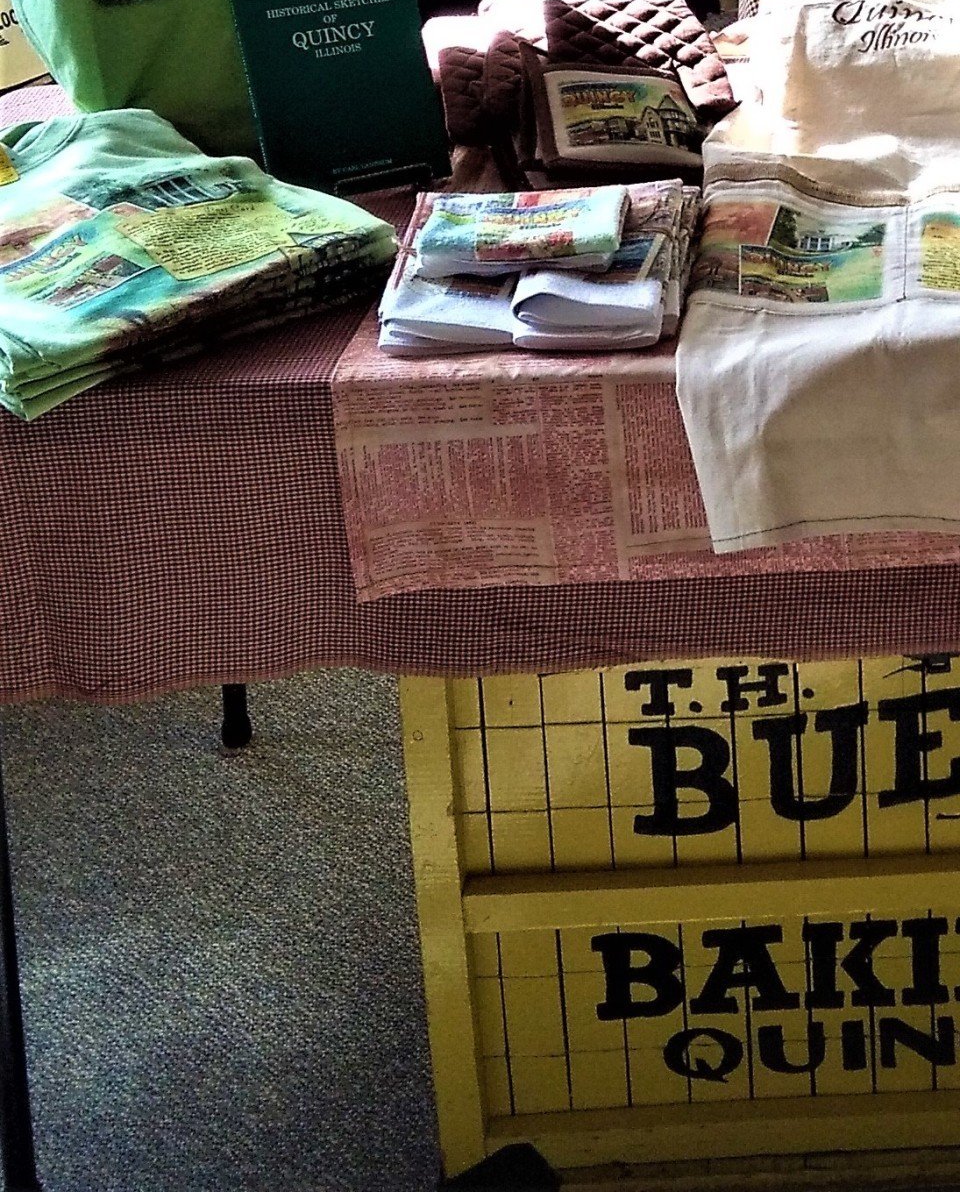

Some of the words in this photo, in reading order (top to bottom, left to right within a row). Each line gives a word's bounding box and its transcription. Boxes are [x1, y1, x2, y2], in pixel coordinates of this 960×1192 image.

[266, 1, 332, 19] HISTORICAL
[323, 14, 338, 24] OF
[292, 20, 376, 51] QUINCY
[858, 22, 931, 54] Illinoi
[315, 42, 362, 59] ILLINOIS
